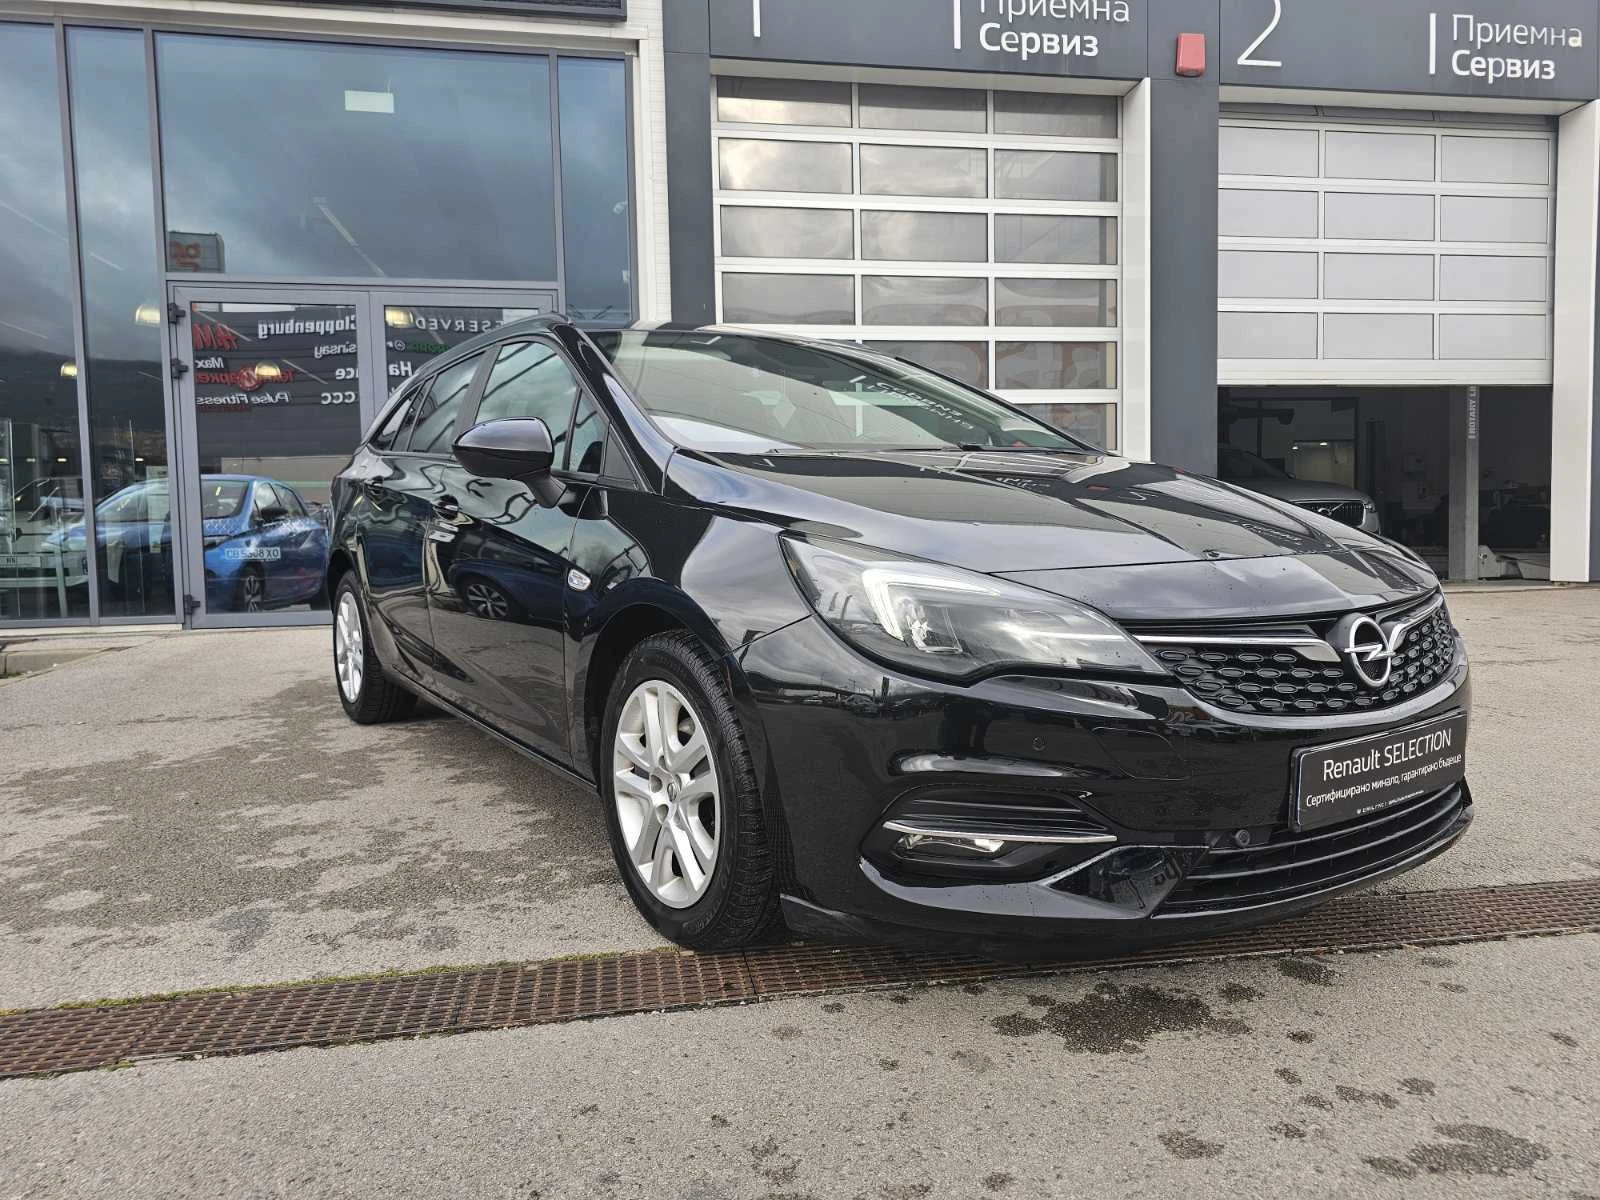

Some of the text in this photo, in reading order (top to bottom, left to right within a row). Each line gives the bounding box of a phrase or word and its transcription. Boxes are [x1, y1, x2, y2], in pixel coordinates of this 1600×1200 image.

[979, 22, 1099, 61] Сервиз
[1237, 0, 1282, 67] 2
[1451, 14, 1583, 50] Приемна
[1451, 49, 1556, 84] Сервиз
[1322, 728, 1453, 782] Renault SELECTION
[1306, 782, 1371, 808] Сертифицирано
[1371, 775, 1400, 793] минало,
[1401, 761, 1438, 784] гарантирано
